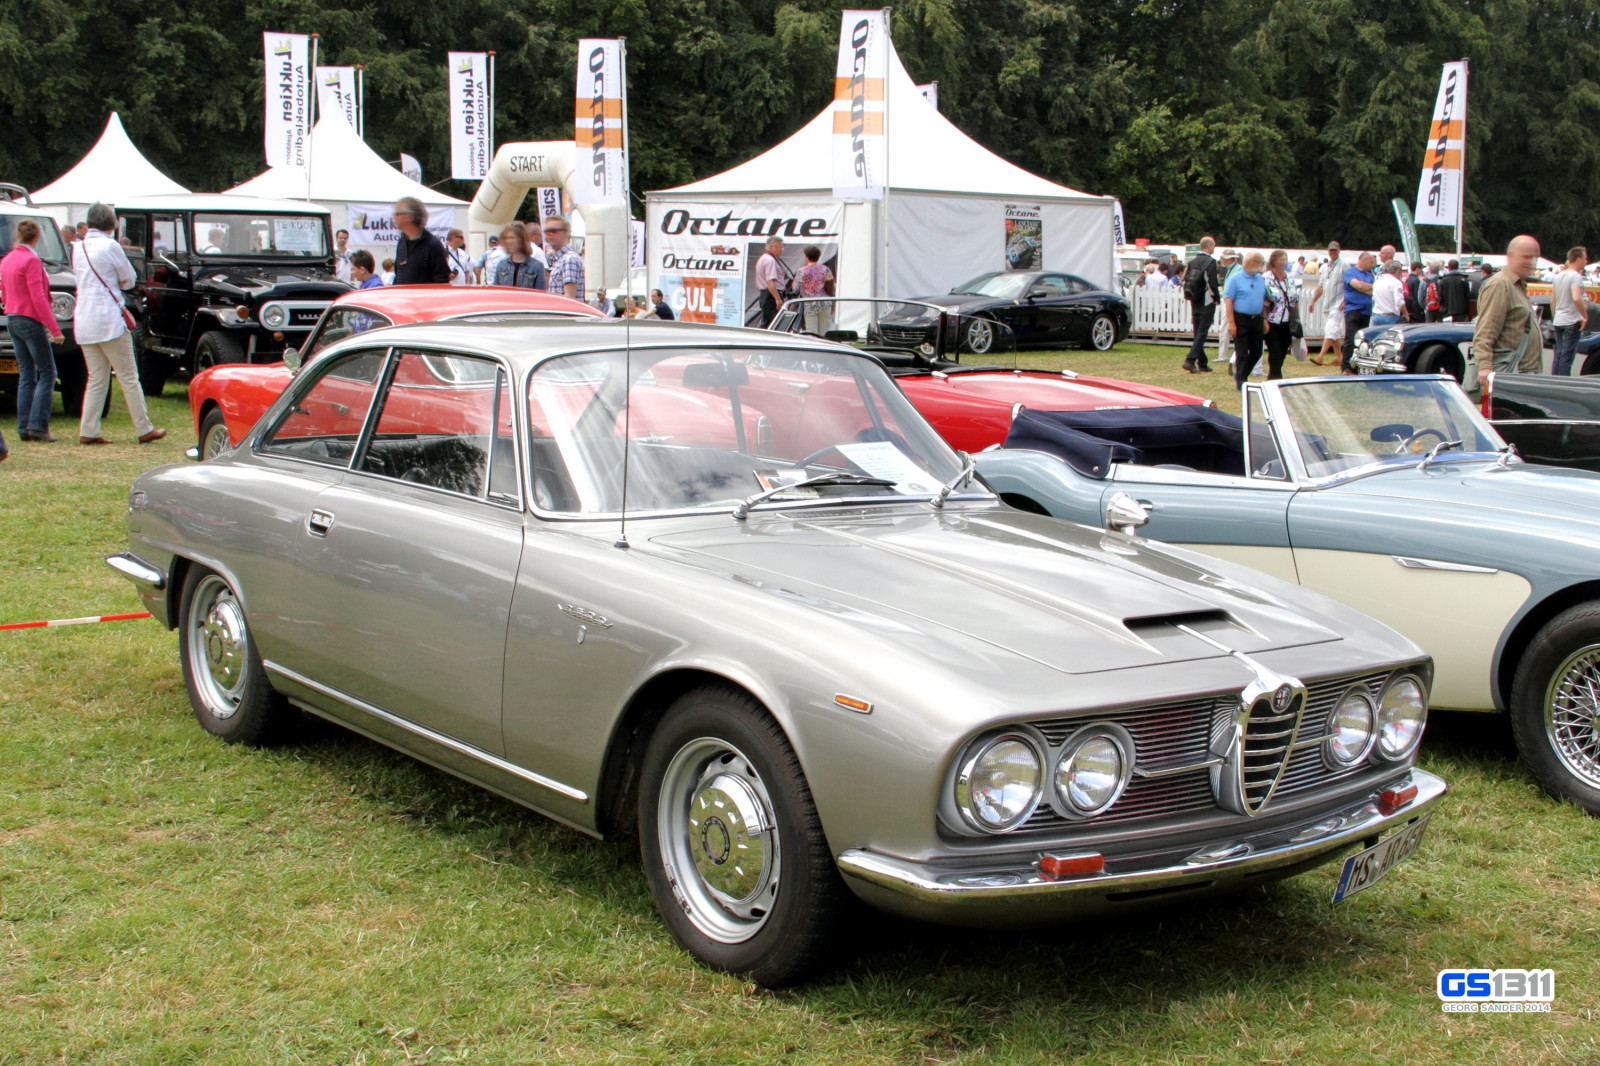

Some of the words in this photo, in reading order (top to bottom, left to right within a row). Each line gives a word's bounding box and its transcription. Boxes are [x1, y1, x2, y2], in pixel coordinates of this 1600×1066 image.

[510, 155, 545, 173] START
[1005, 208, 1040, 217] Octane
[661, 209, 839, 237] Octane
[662, 253, 740, 271] Octane
[671, 286, 725, 313] GULF
